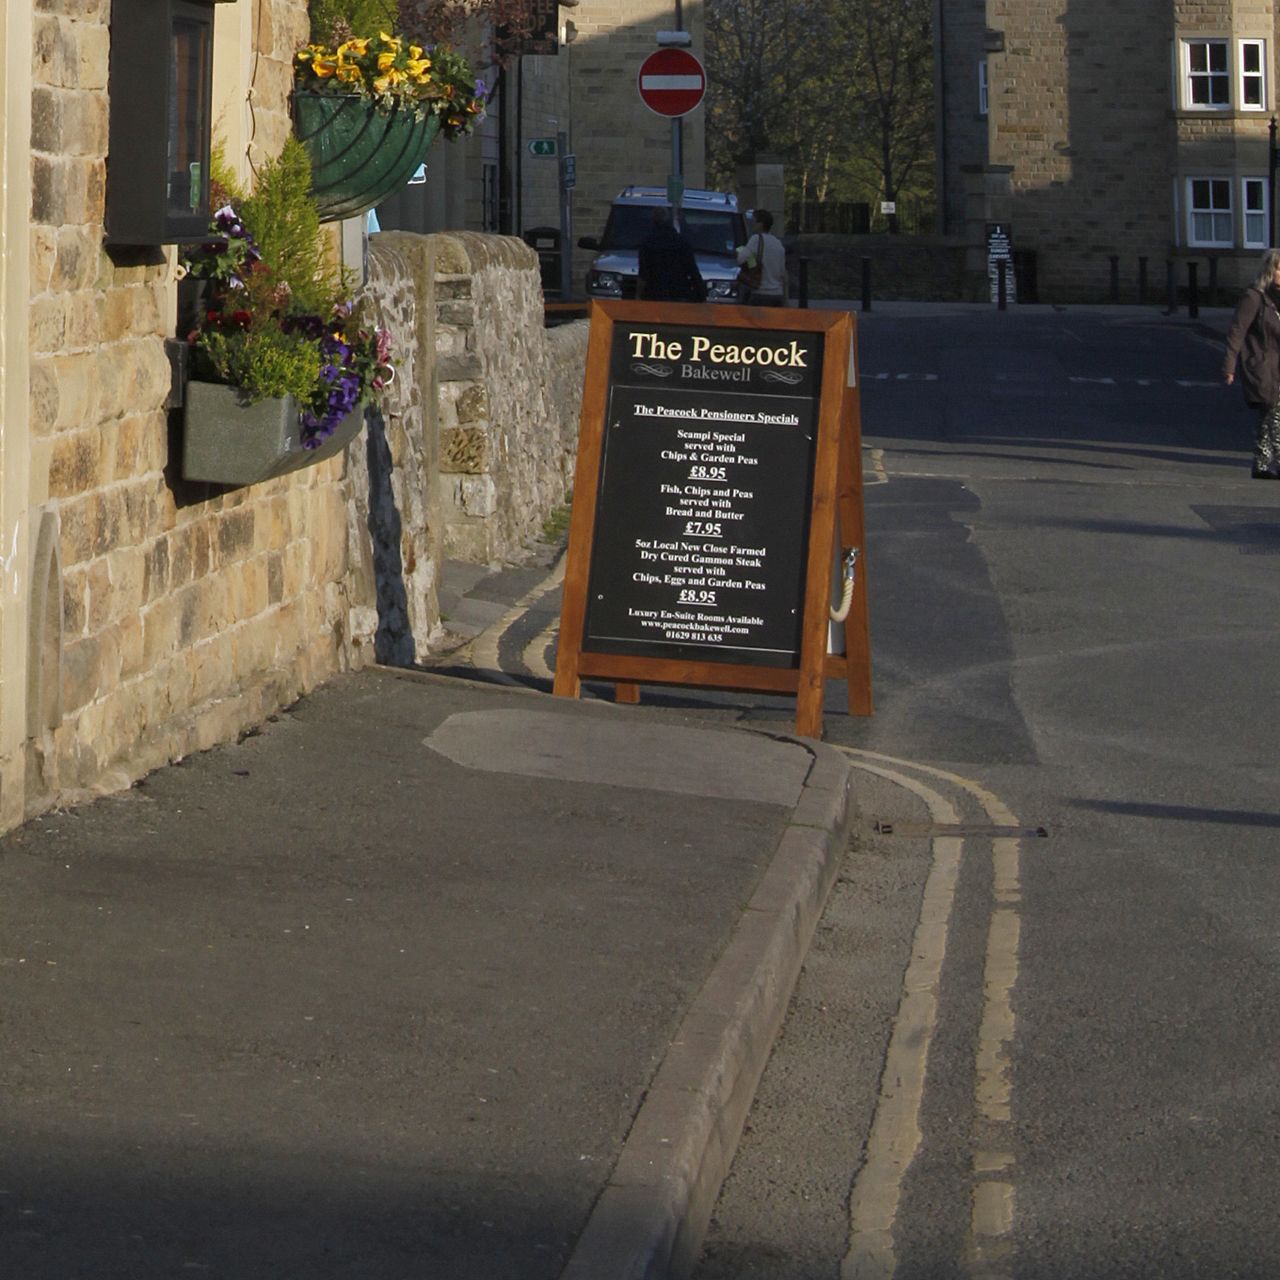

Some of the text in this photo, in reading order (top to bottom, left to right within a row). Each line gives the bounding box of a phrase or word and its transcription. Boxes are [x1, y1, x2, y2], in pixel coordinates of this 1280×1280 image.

[629, 333, 807, 367] The Peacock
[682, 365, 751, 382] Bakewell
[634, 405, 799, 425] The Peacock Pensioners Specials
[677, 430, 745, 442] Scampi Special
[684, 442, 736, 452] served with
[661, 451, 758, 465] Chips & Garden Peas
[690, 466, 726, 479] £8.95
[660, 484, 753, 498] Fish, Chips and Peas
[680, 498, 731, 508] served with
[666, 507, 744, 520] Bread and Butter
[685, 522, 722, 535] £7.95
[636, 539, 766, 556] 5oz Local New Close Farmed
[641, 551, 761, 567] Dry Cured Gammon Steak
[674, 566, 726, 576] served with
[633, 573, 766, 590] Chips, Eggs and Garden Peas
[679, 590, 716, 603] £8.95
[628, 608, 764, 625] Luxury En-Suite Rooms Available
[641, 621, 749, 634] www.peacockbakewell.com
